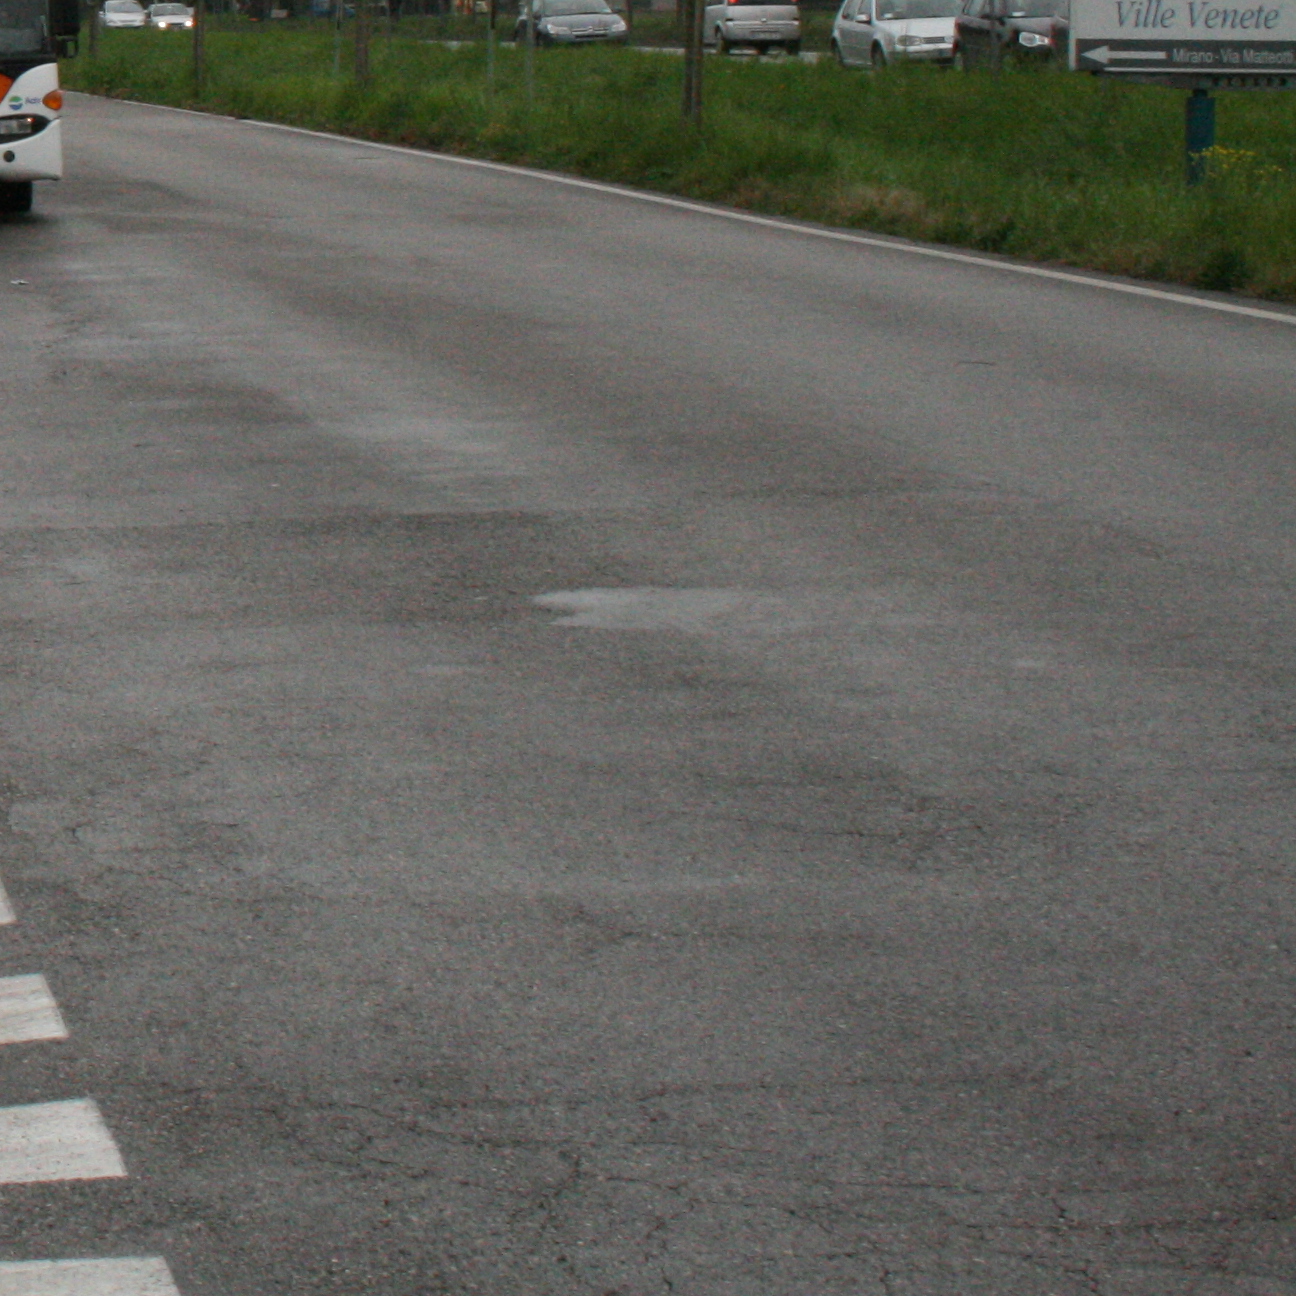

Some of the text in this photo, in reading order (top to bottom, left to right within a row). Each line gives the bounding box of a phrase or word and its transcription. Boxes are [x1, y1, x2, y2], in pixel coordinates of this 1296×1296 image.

[1187, 1, 1280, 30] Venete
[1172, 47, 1214, 64] Mirano
[1220, 47, 1240, 64] Via
